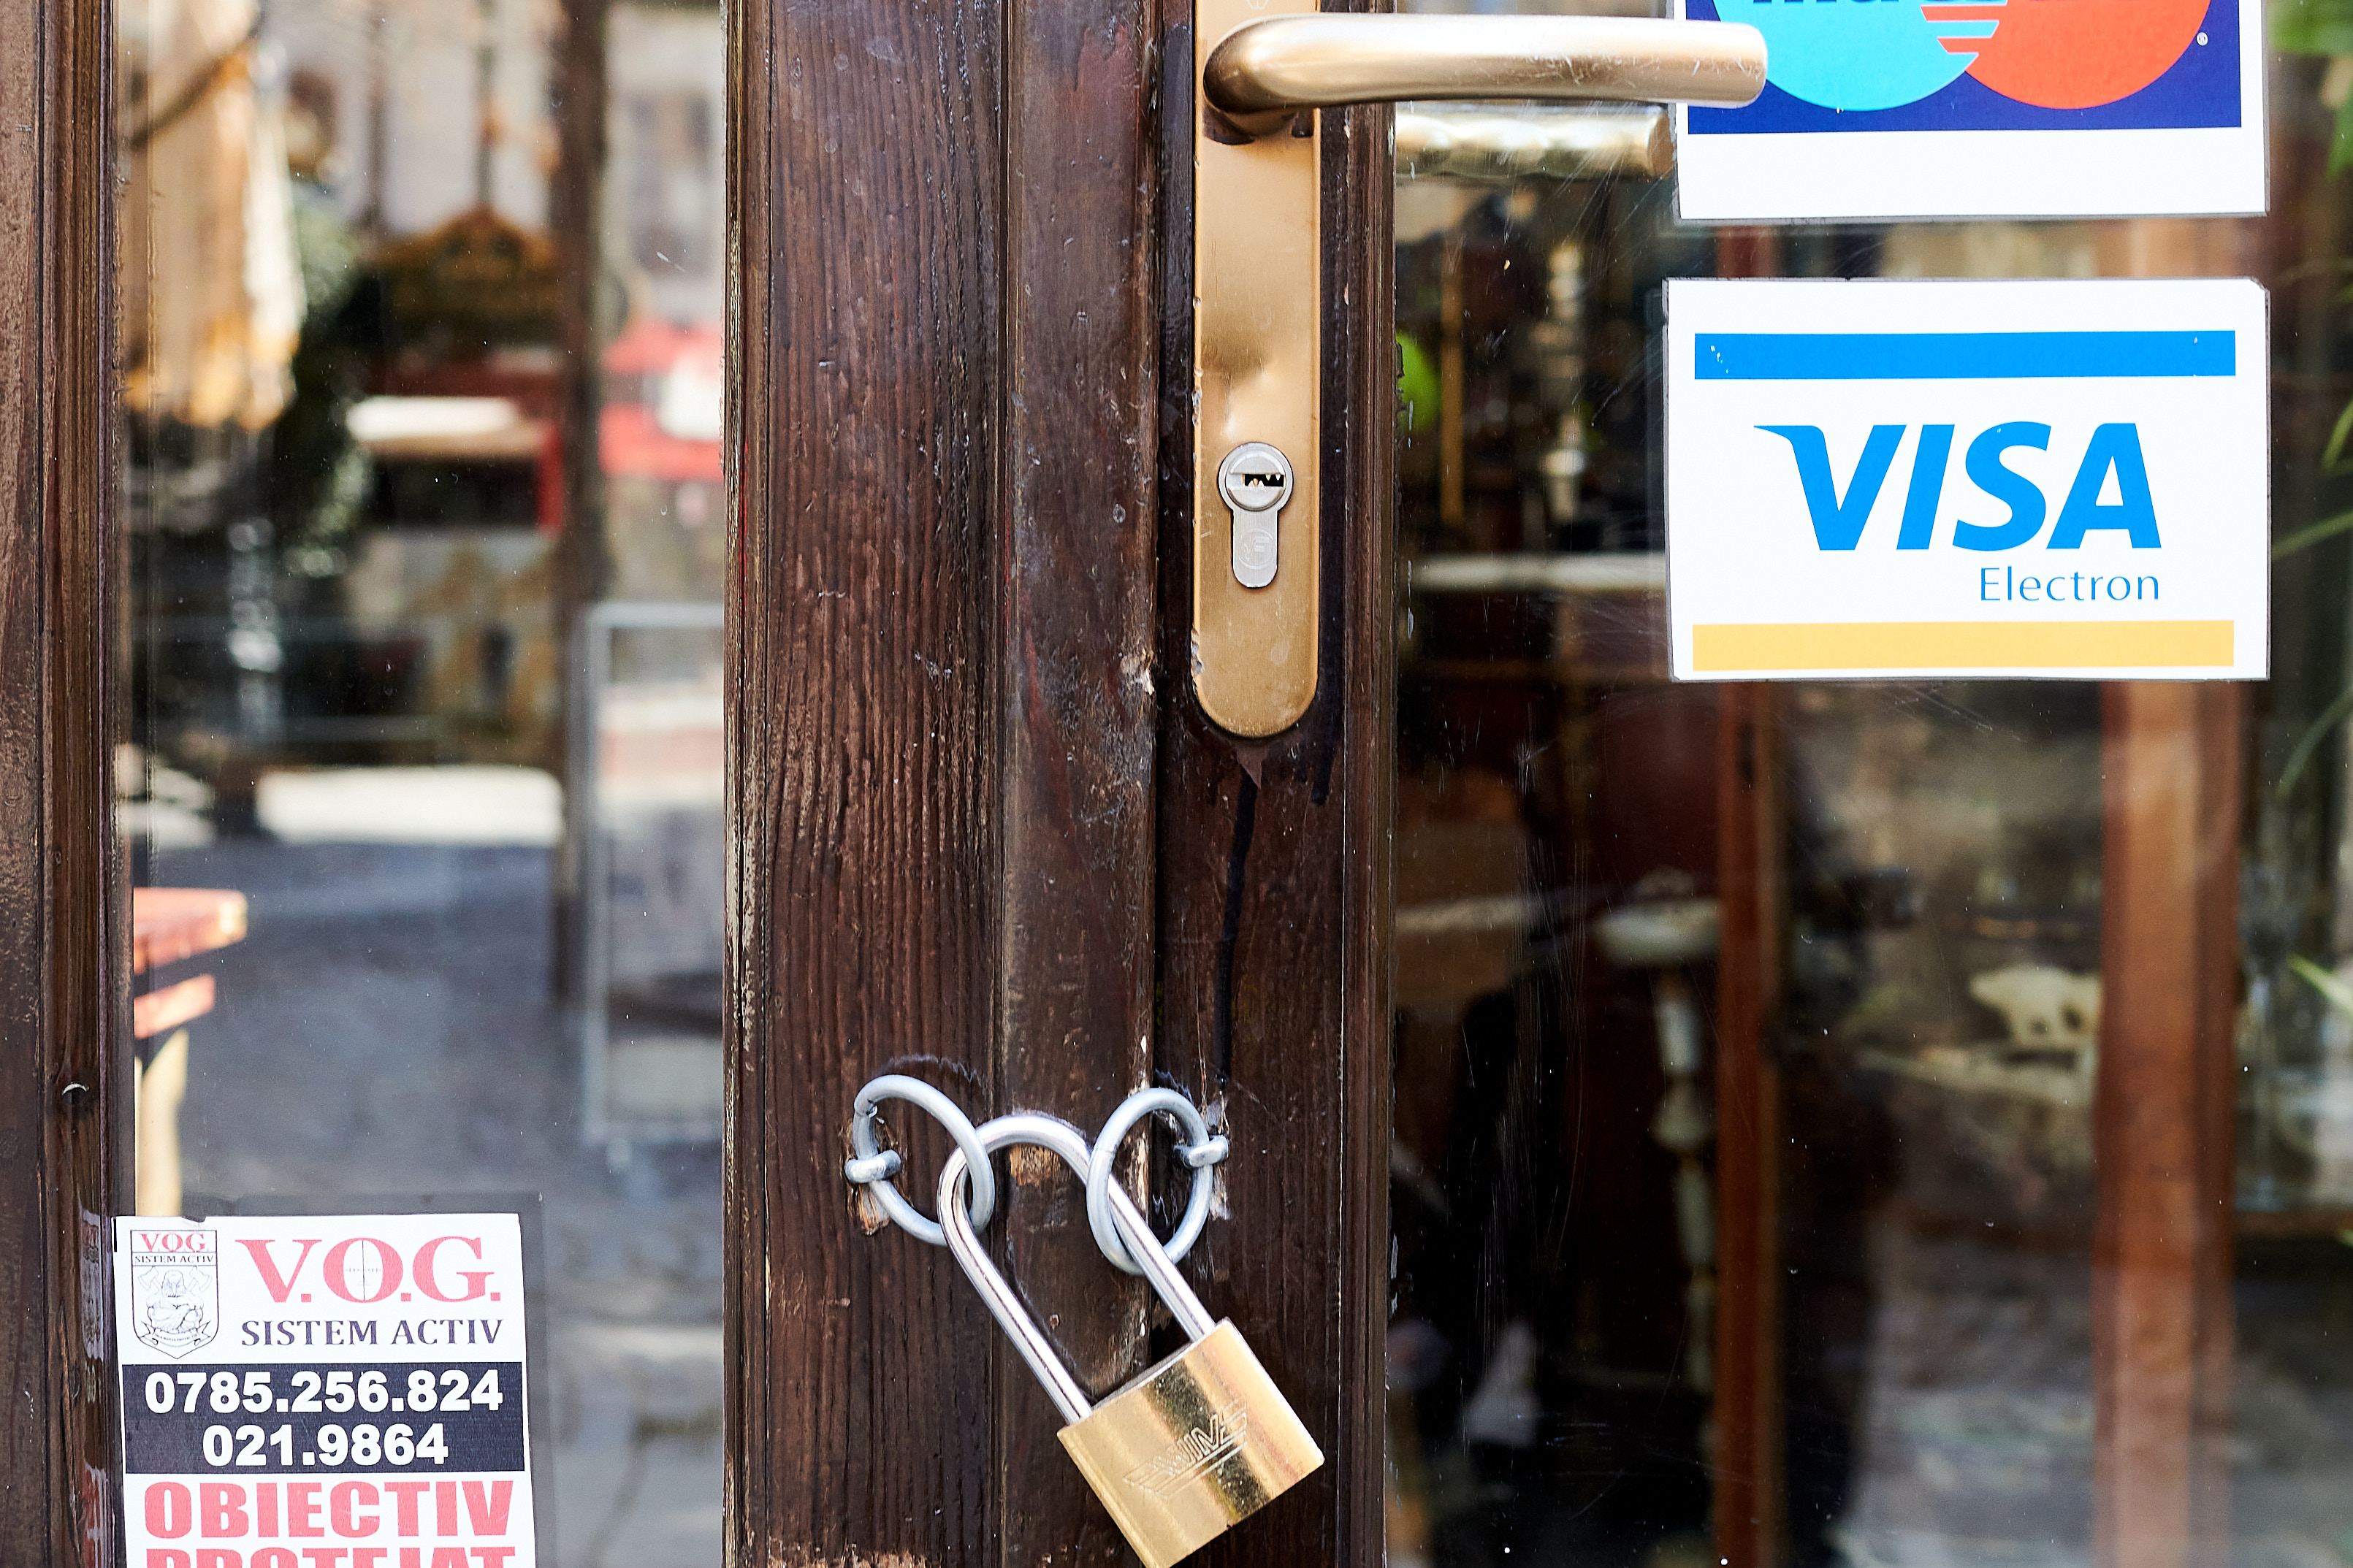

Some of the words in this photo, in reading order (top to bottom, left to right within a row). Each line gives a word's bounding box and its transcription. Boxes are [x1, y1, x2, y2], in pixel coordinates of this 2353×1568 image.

[1753, 421, 2162, 551] VISA
[1980, 566, 2159, 602] Electron
[235, 1236, 501, 1304] V.O.G.
[241, 1320, 378, 1347] SISTEM
[391, 1319, 503, 1345] ACTIV
[145, 1369, 503, 1414] 0785.256.824
[202, 1423, 449, 1466] 021.9864
[144, 1480, 514, 1540] OBIECTIV
